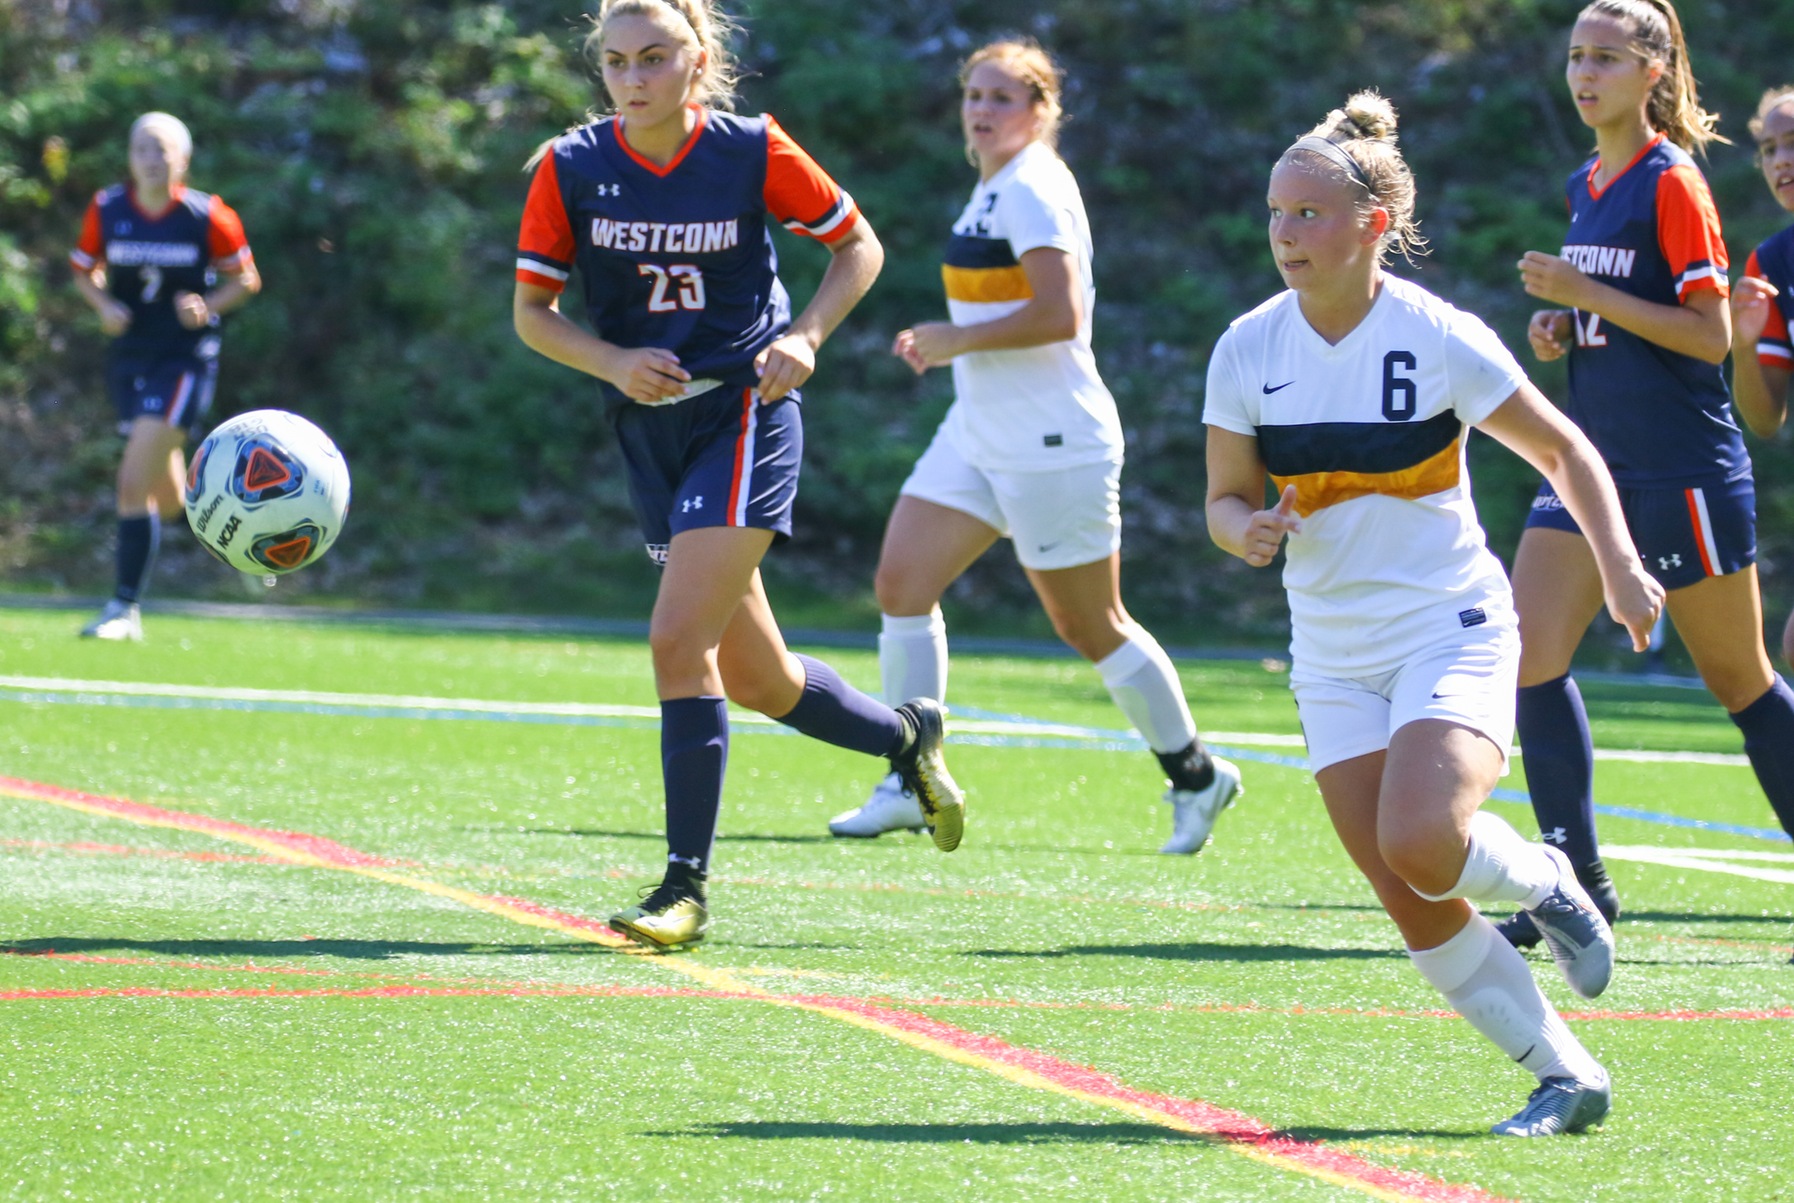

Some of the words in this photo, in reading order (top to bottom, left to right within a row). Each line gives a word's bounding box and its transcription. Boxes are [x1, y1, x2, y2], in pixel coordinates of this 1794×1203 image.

[591, 217, 739, 254] WESTCONN
[637, 263, 707, 313] 23
[1382, 350, 1417, 421] 6
[196, 494, 224, 533] Wilson
[216, 511, 243, 550] NCAA
